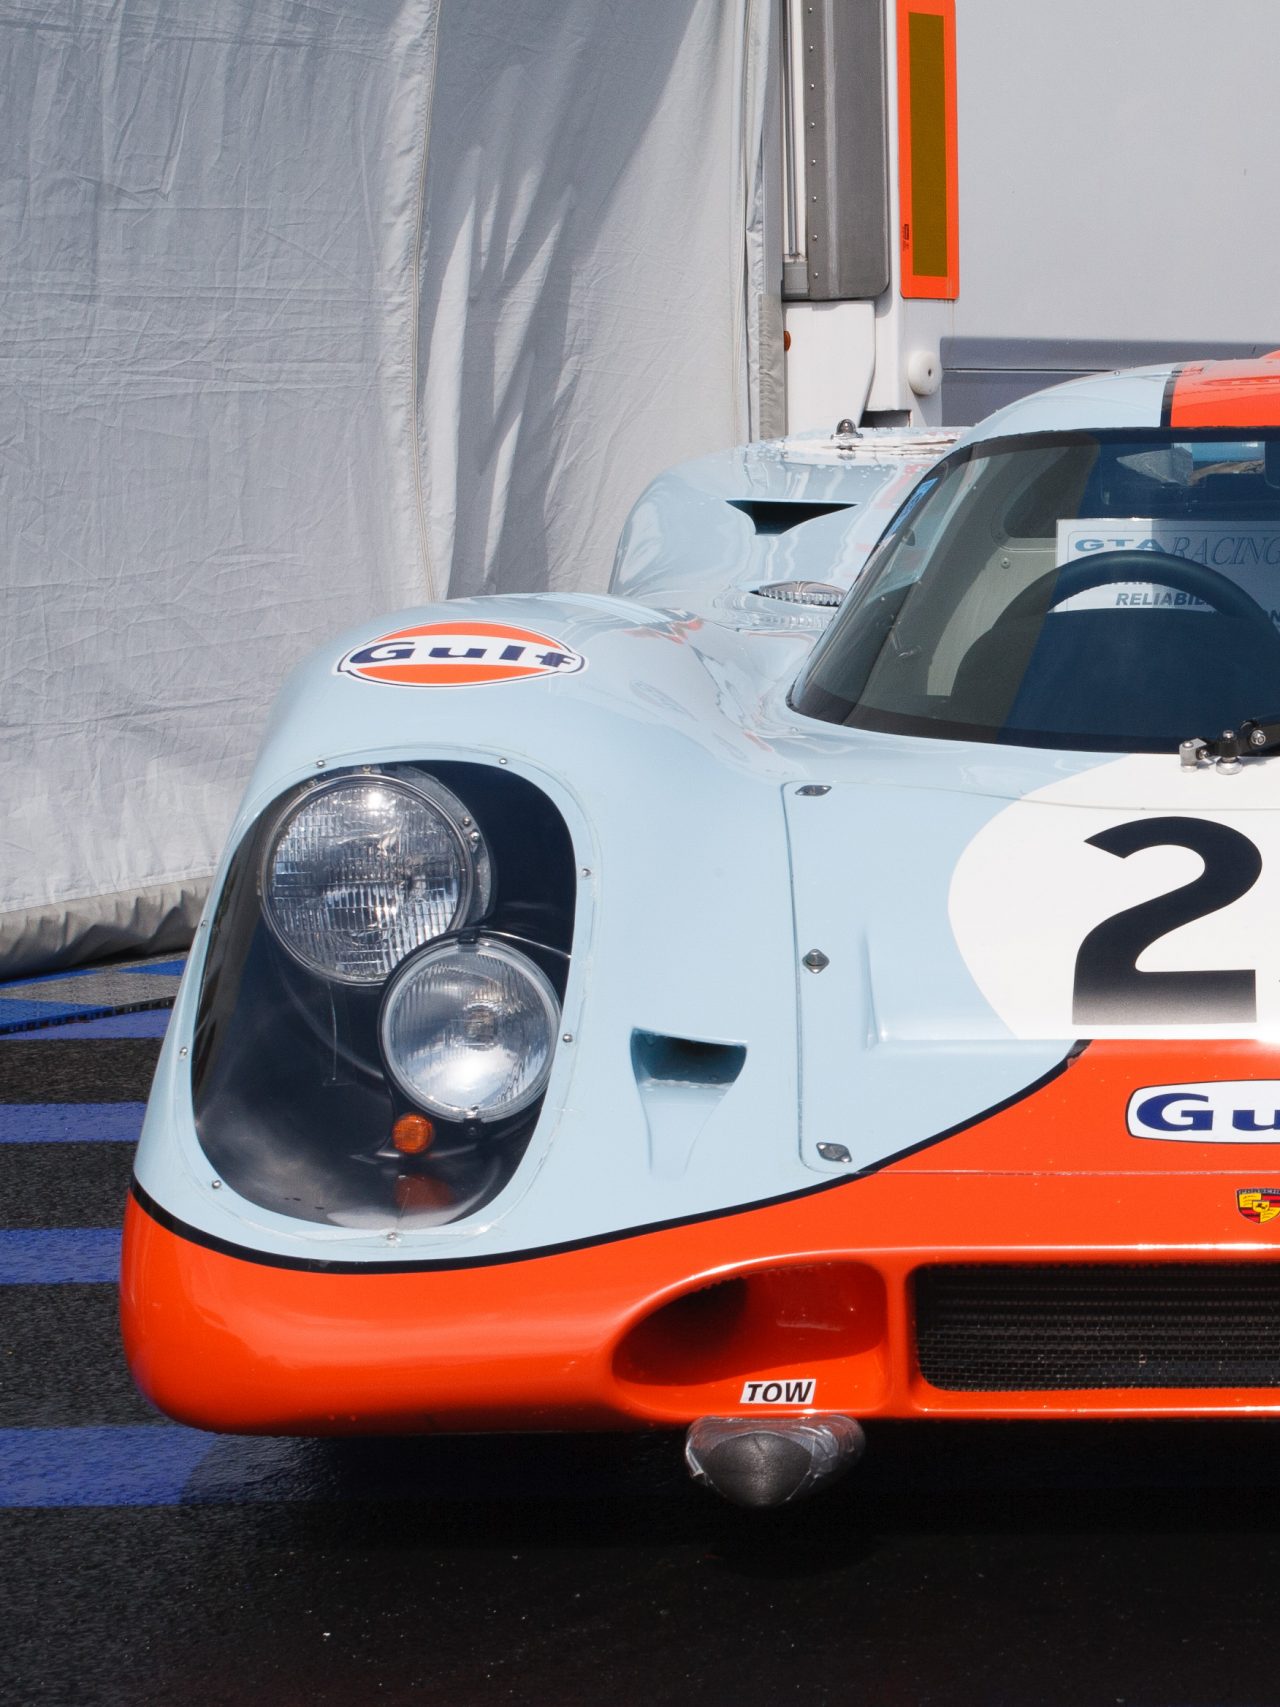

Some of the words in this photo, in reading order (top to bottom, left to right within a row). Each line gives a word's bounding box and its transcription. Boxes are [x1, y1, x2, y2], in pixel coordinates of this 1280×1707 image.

[1115, 592, 1208, 606] RELIABIL
[349, 641, 576, 668] Gulf
[747, 1381, 813, 1402] TOW
